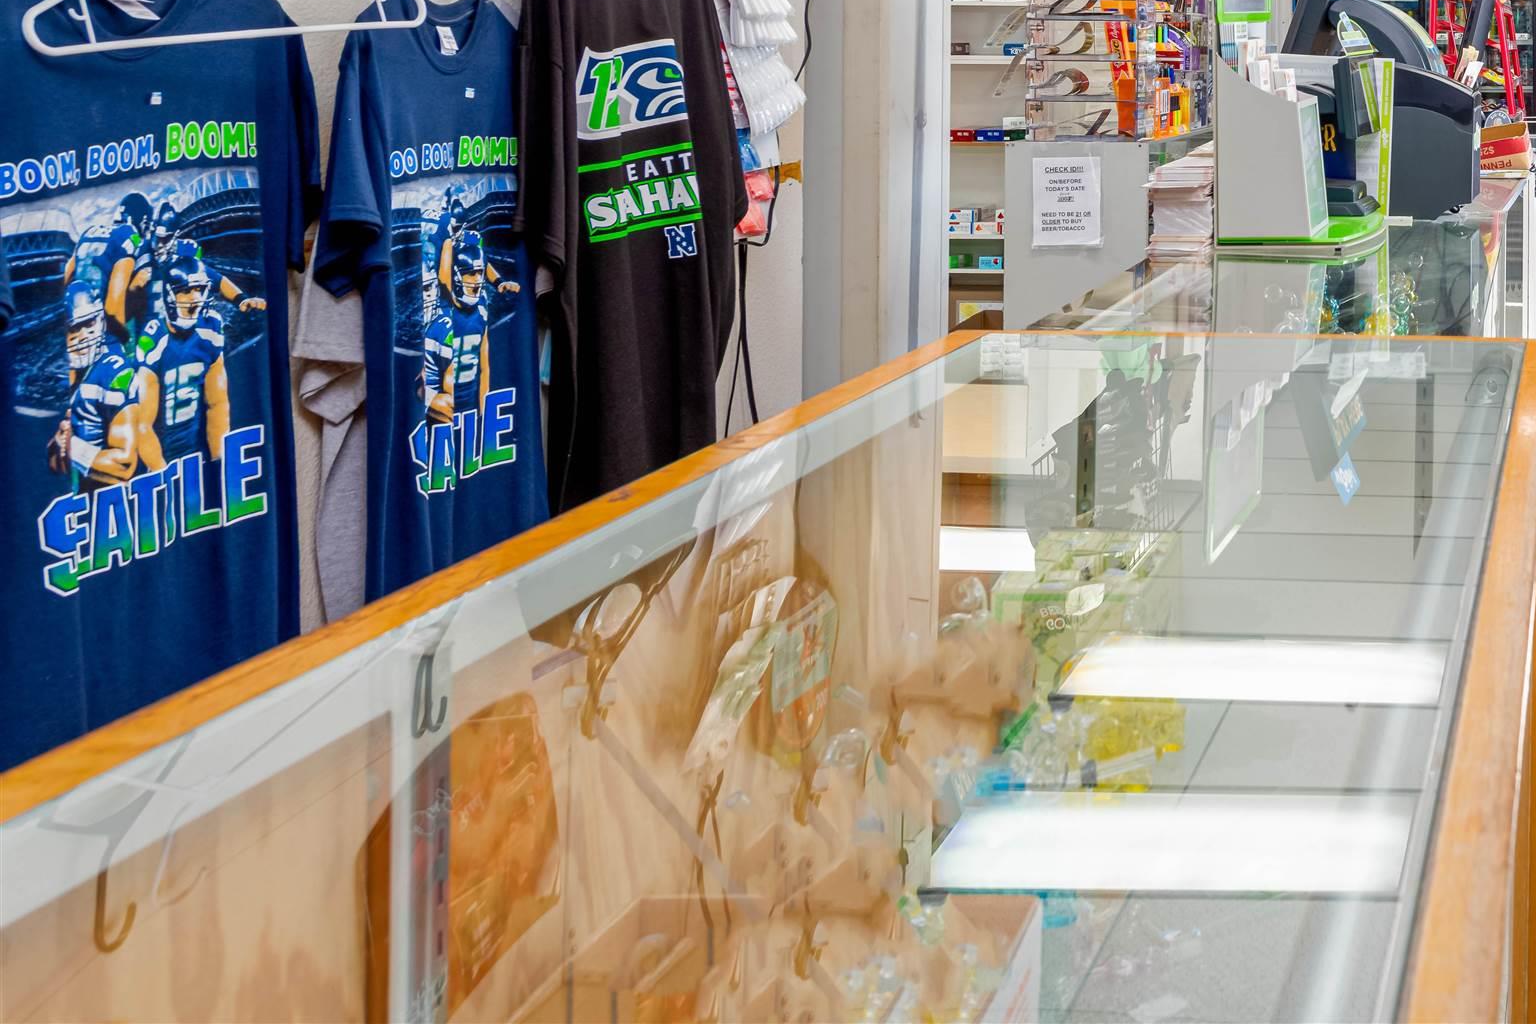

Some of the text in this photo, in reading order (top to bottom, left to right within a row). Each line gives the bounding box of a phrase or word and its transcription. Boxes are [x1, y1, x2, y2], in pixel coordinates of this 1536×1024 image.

[0, 120, 257, 199] BOOM, BOOM, BOOM!
